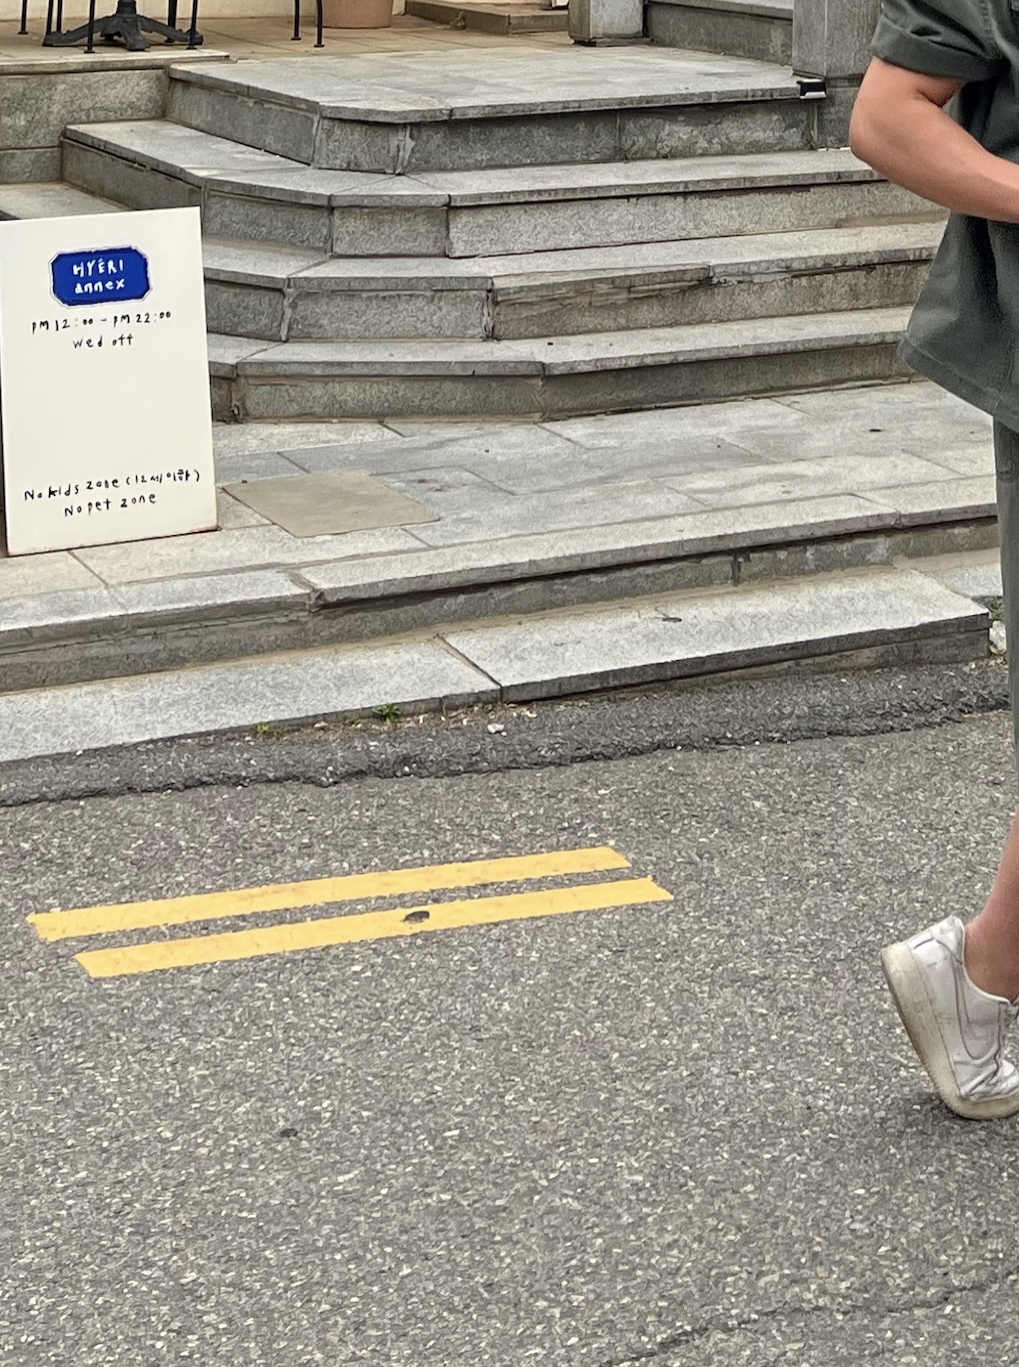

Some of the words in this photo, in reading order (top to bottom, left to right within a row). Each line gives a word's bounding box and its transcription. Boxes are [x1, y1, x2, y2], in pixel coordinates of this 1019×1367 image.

[75, 279, 125, 294] annex
[55, 318, 94, 331] 12:00
[136, 311, 171, 323] 22:00
[112, 333, 133, 346] off
[87, 498, 111, 515] pet
[120, 493, 157, 508] zone
